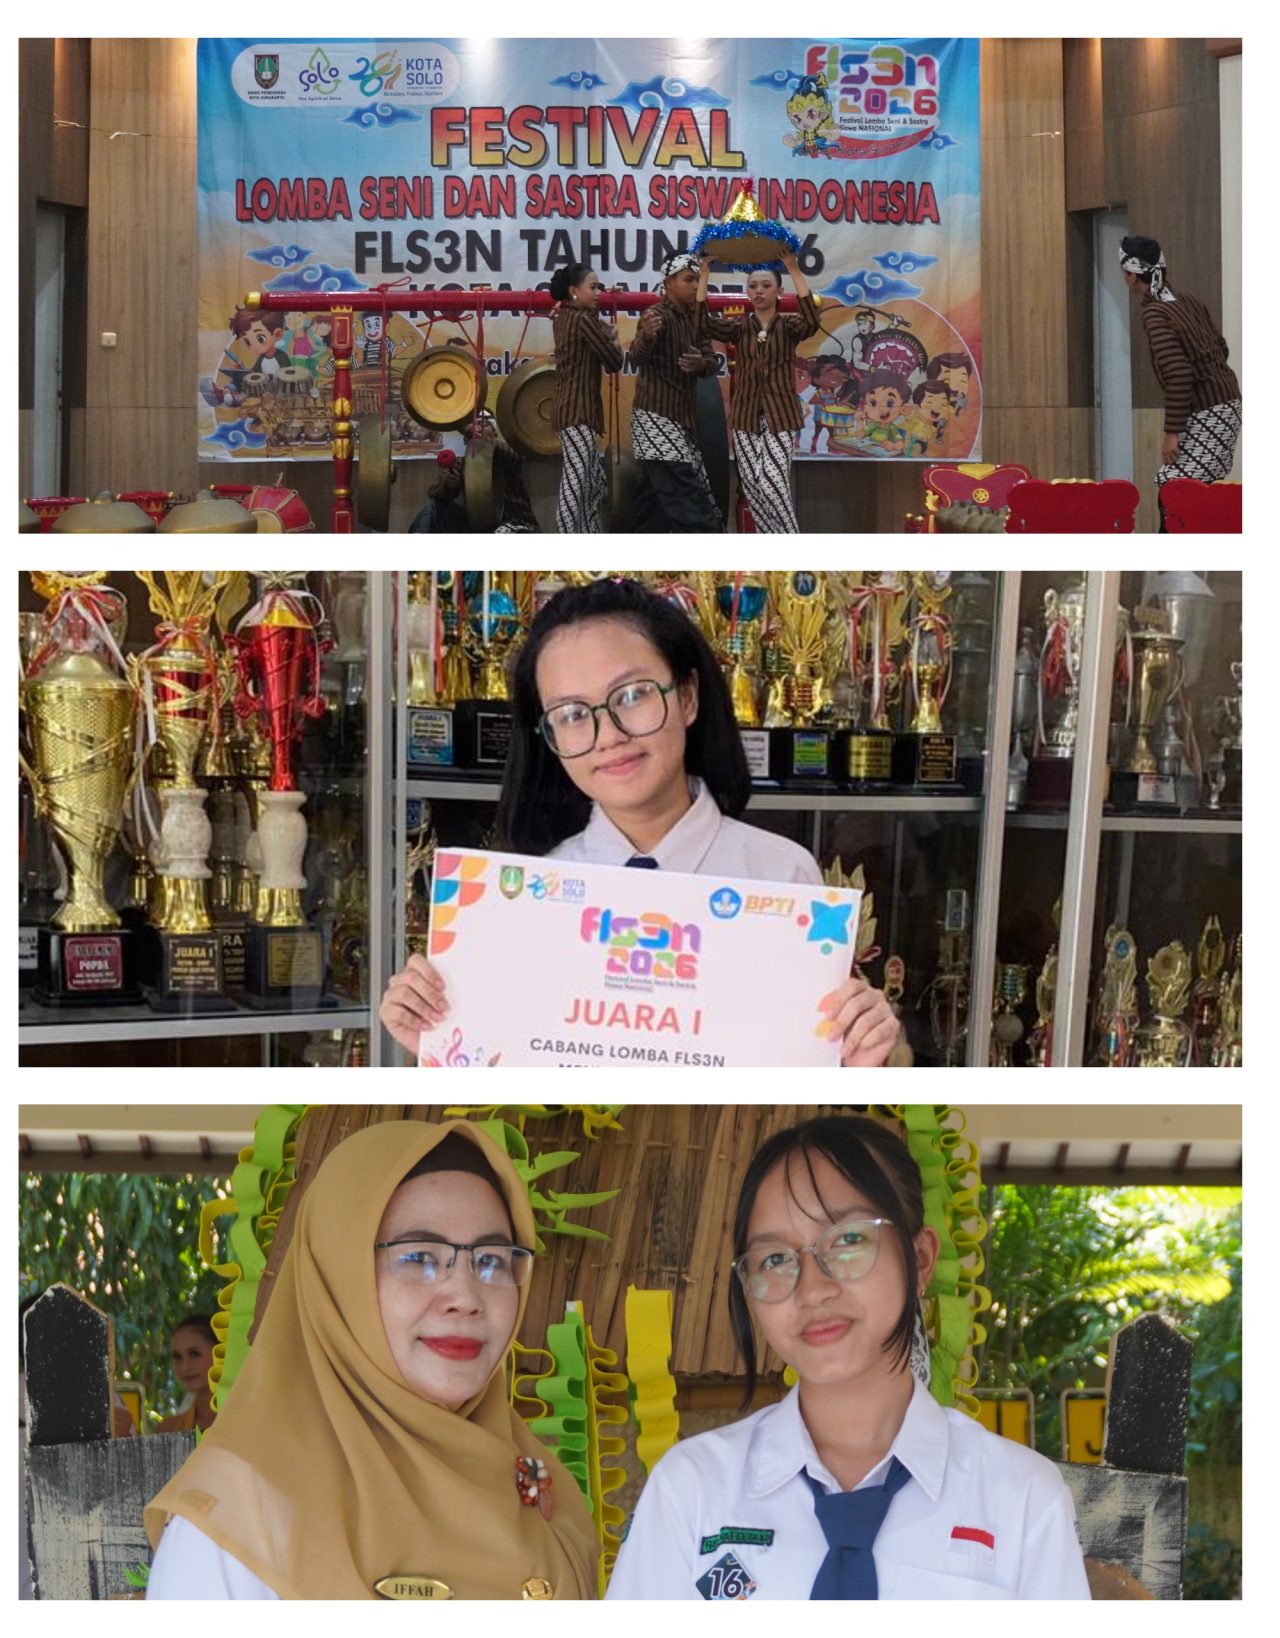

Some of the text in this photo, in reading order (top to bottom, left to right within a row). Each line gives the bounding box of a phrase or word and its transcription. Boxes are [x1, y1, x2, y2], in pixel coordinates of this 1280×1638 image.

[406, 58, 442, 71] KOTA
[406, 72, 443, 85] SOLO
[839, 87, 937, 115] 2026
[430, 105, 745, 168] FESTIVAL
[235, 177, 352, 221] LOMBA
[359, 175, 434, 219] SENI
[444, 174, 516, 219] DAN
[525, 174, 641, 220] SASTRA
[759, 178, 940, 224] INDONESIA
[354, 229, 689, 274] FLS3N TAHUN
[745, 895, 795, 912] BPTI
[606, 948, 698, 980] 2026
[564, 998, 681, 1034] JUARA
[530, 1038, 726, 1067] CABANG LOMBA FLS3N
[394, 1583, 433, 1598] IFFAH
[708, 1567, 743, 1599] 16
